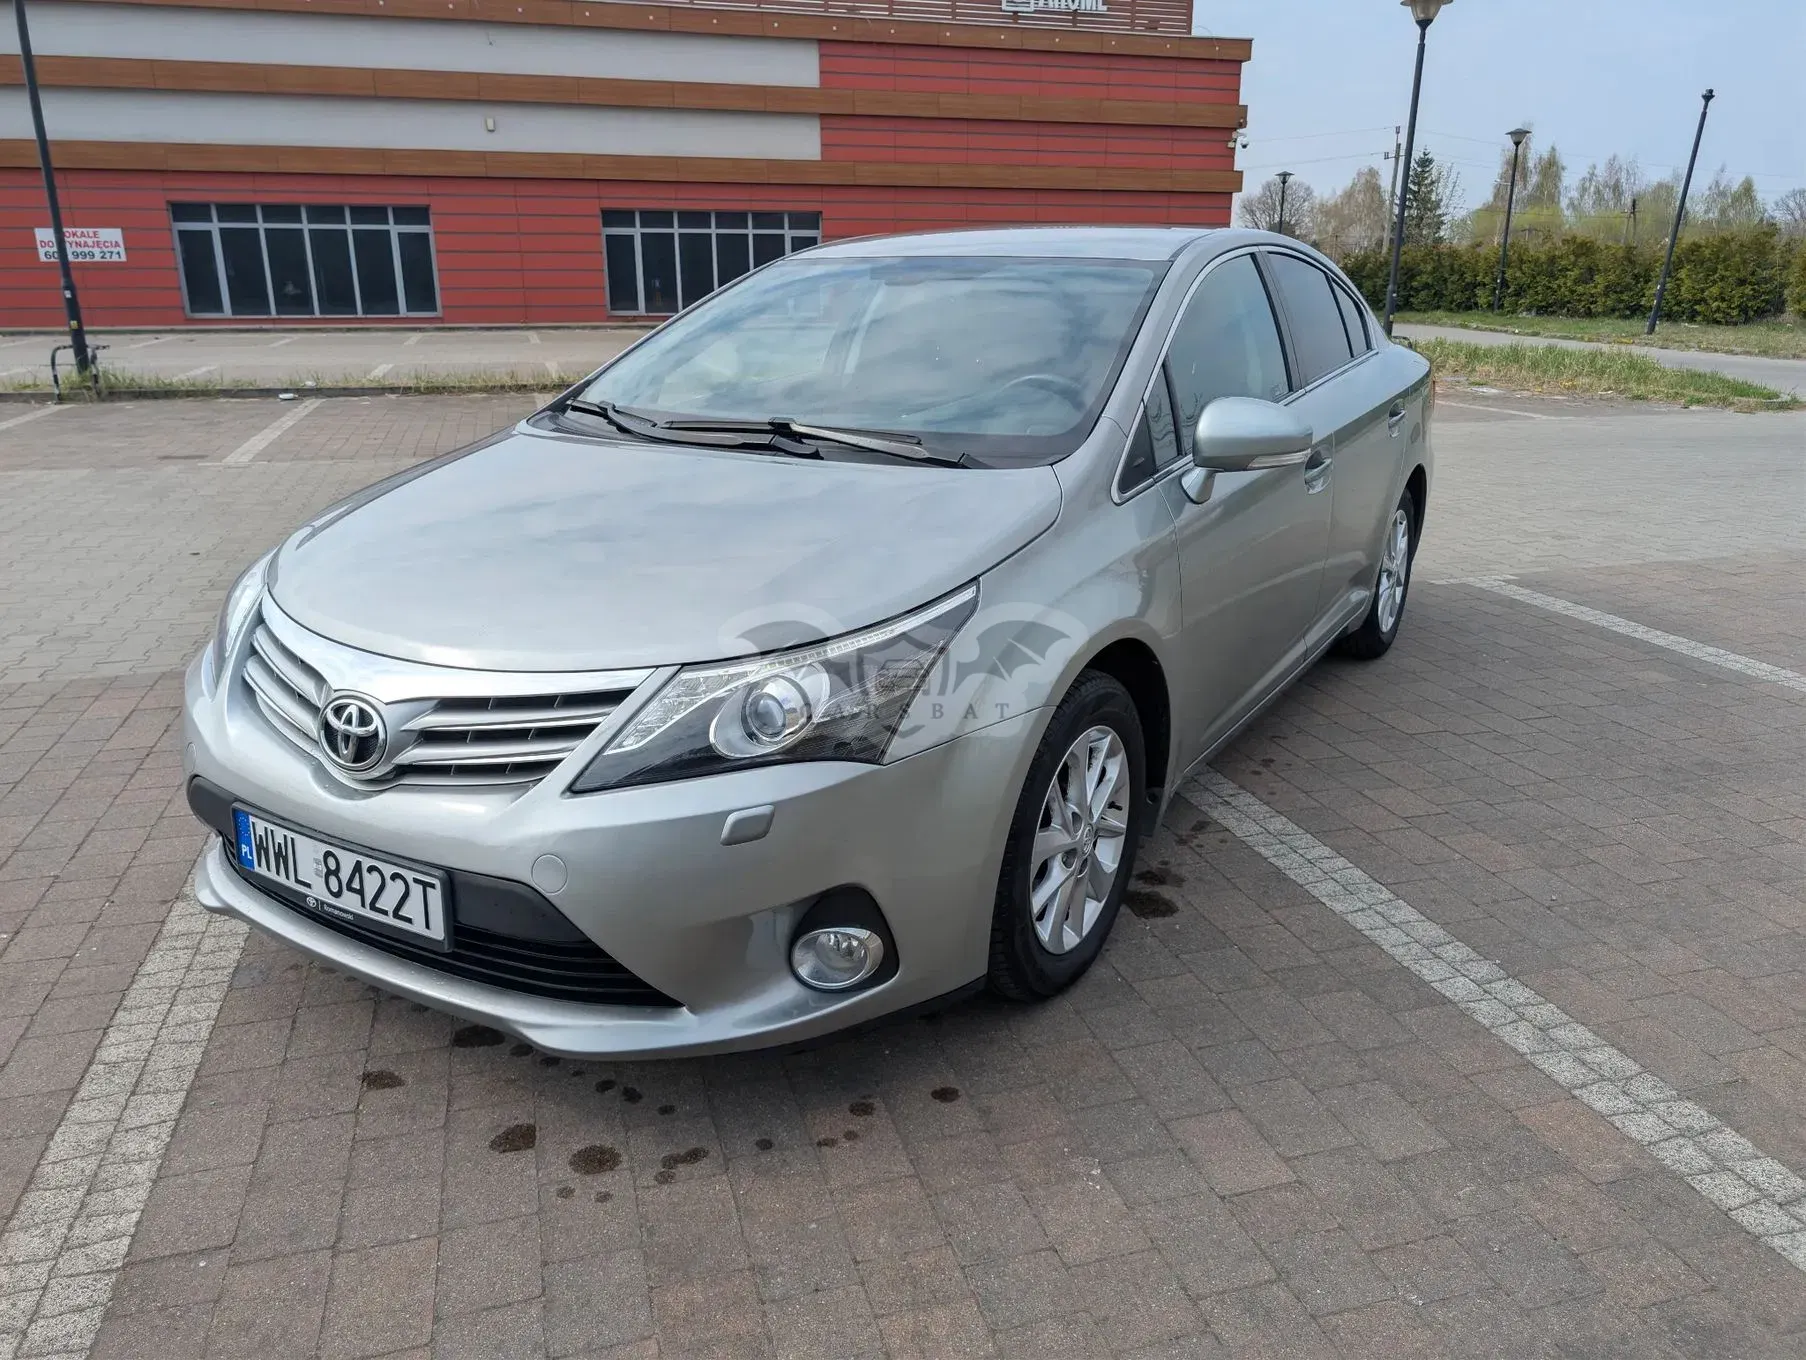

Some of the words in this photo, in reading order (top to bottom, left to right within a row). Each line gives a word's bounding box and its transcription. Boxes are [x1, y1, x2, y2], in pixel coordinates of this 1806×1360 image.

[63, 230, 99, 239] OKALE
[40, 240, 55, 248] DO
[67, 240, 121, 249] YNAJĘCIA
[44, 251, 60, 259] 60
[71, 251, 96, 260] 999
[100, 251, 122, 260] 271
[241, 843, 253, 860] PL
[251, 820, 312, 889] WWL
[323, 849, 436, 930] 8422T
